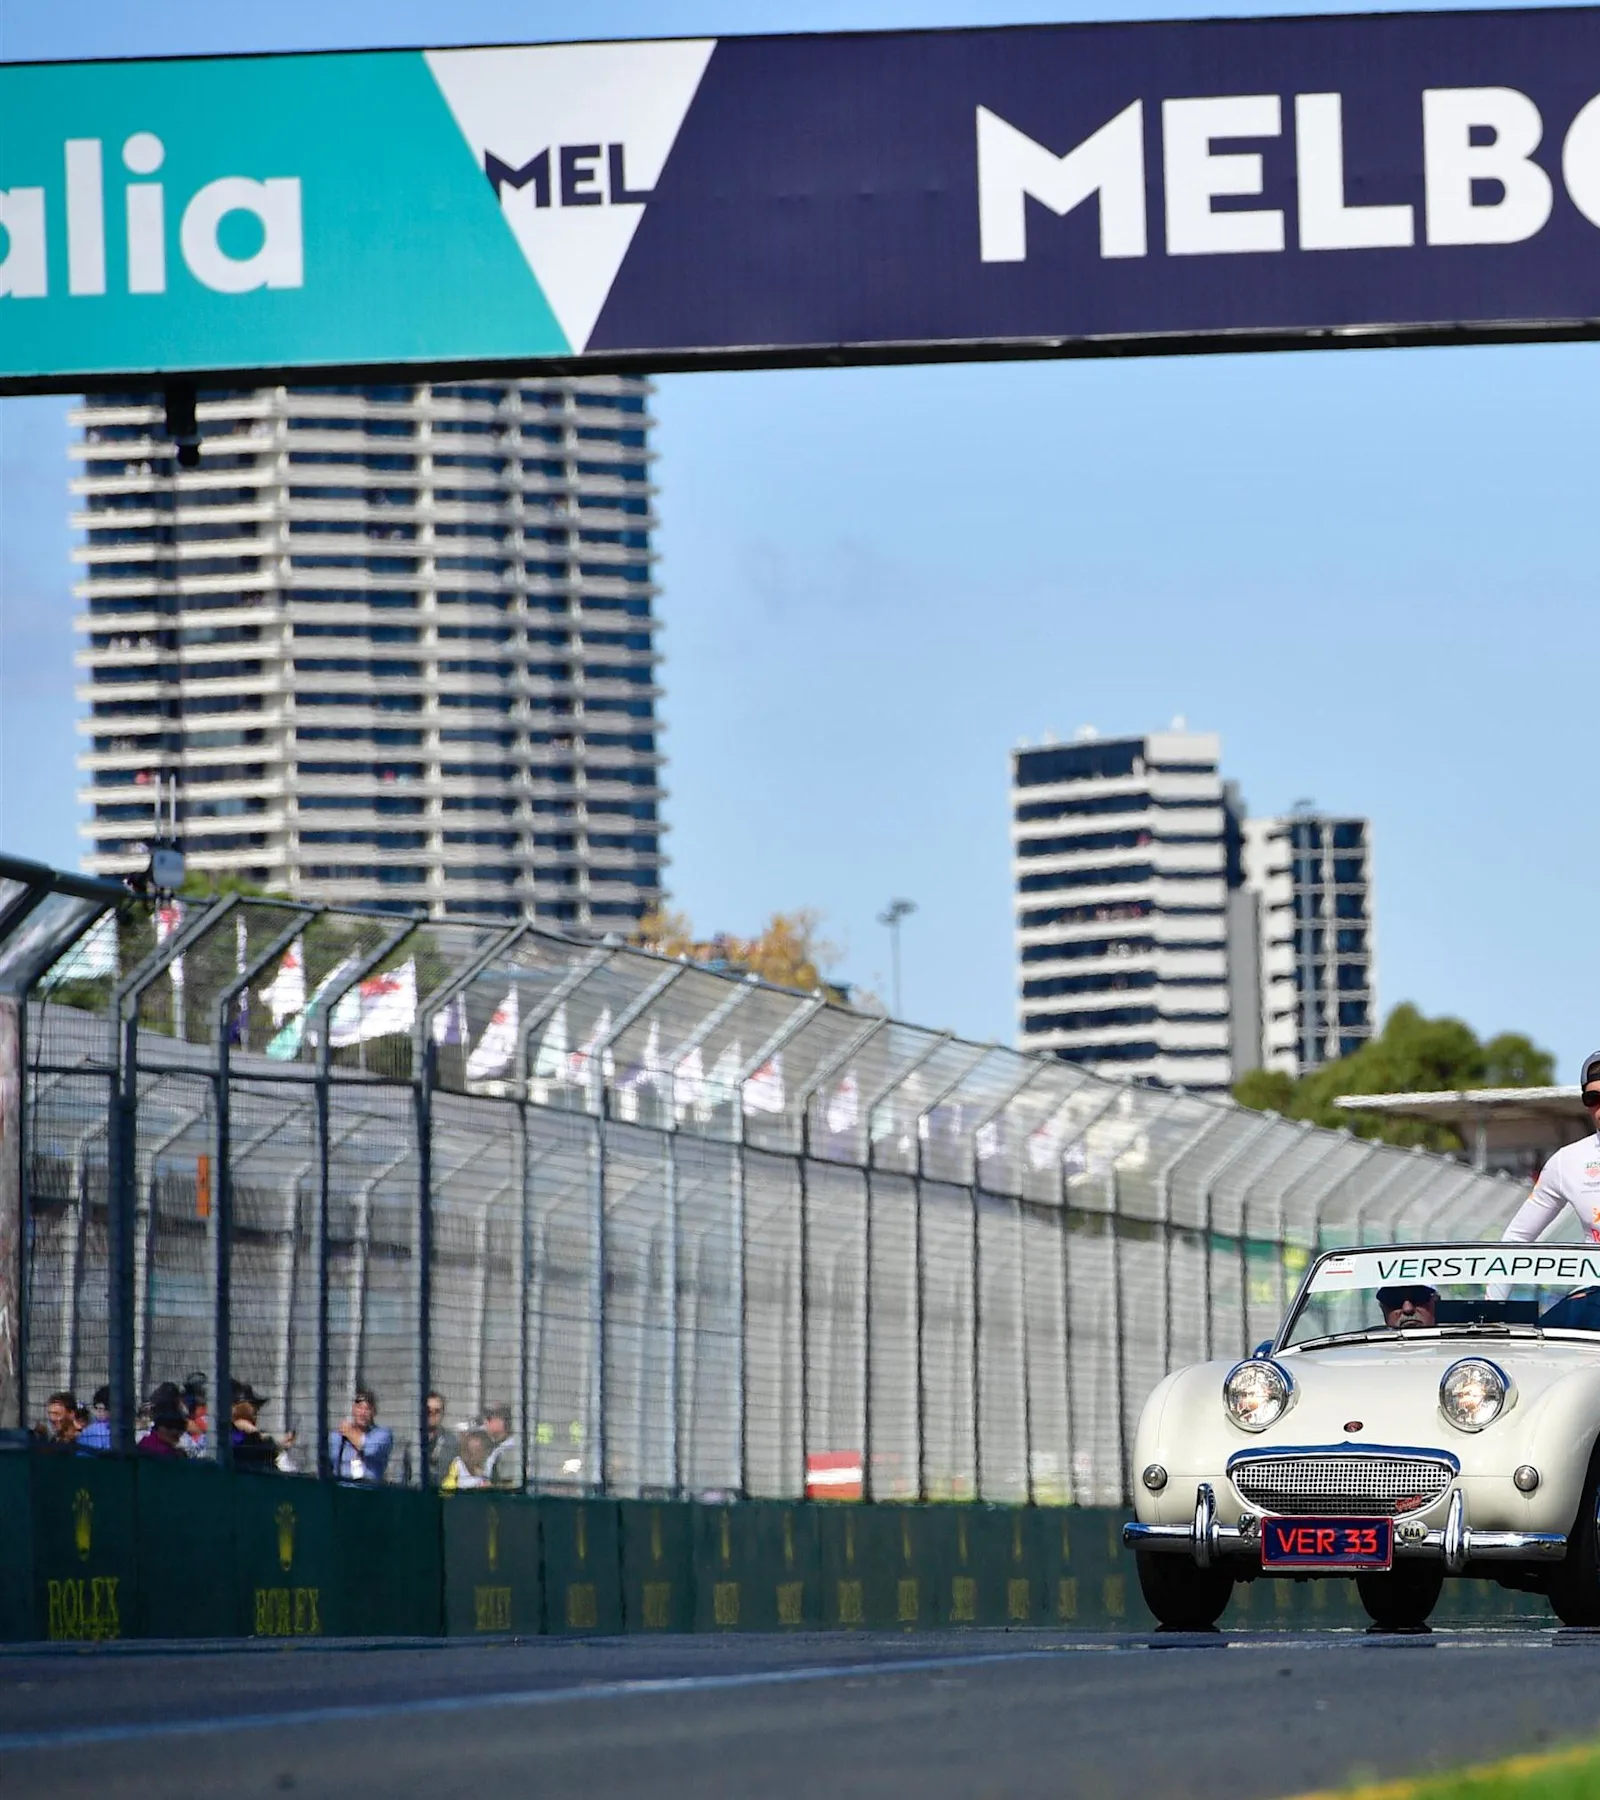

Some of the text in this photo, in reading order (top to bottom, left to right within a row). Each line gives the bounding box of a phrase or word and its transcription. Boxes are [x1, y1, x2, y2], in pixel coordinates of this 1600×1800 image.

[483, 142, 656, 209] MEL
[1276, 1527, 1378, 1554] VER 33
[1404, 1527, 1420, 1538] RAA
